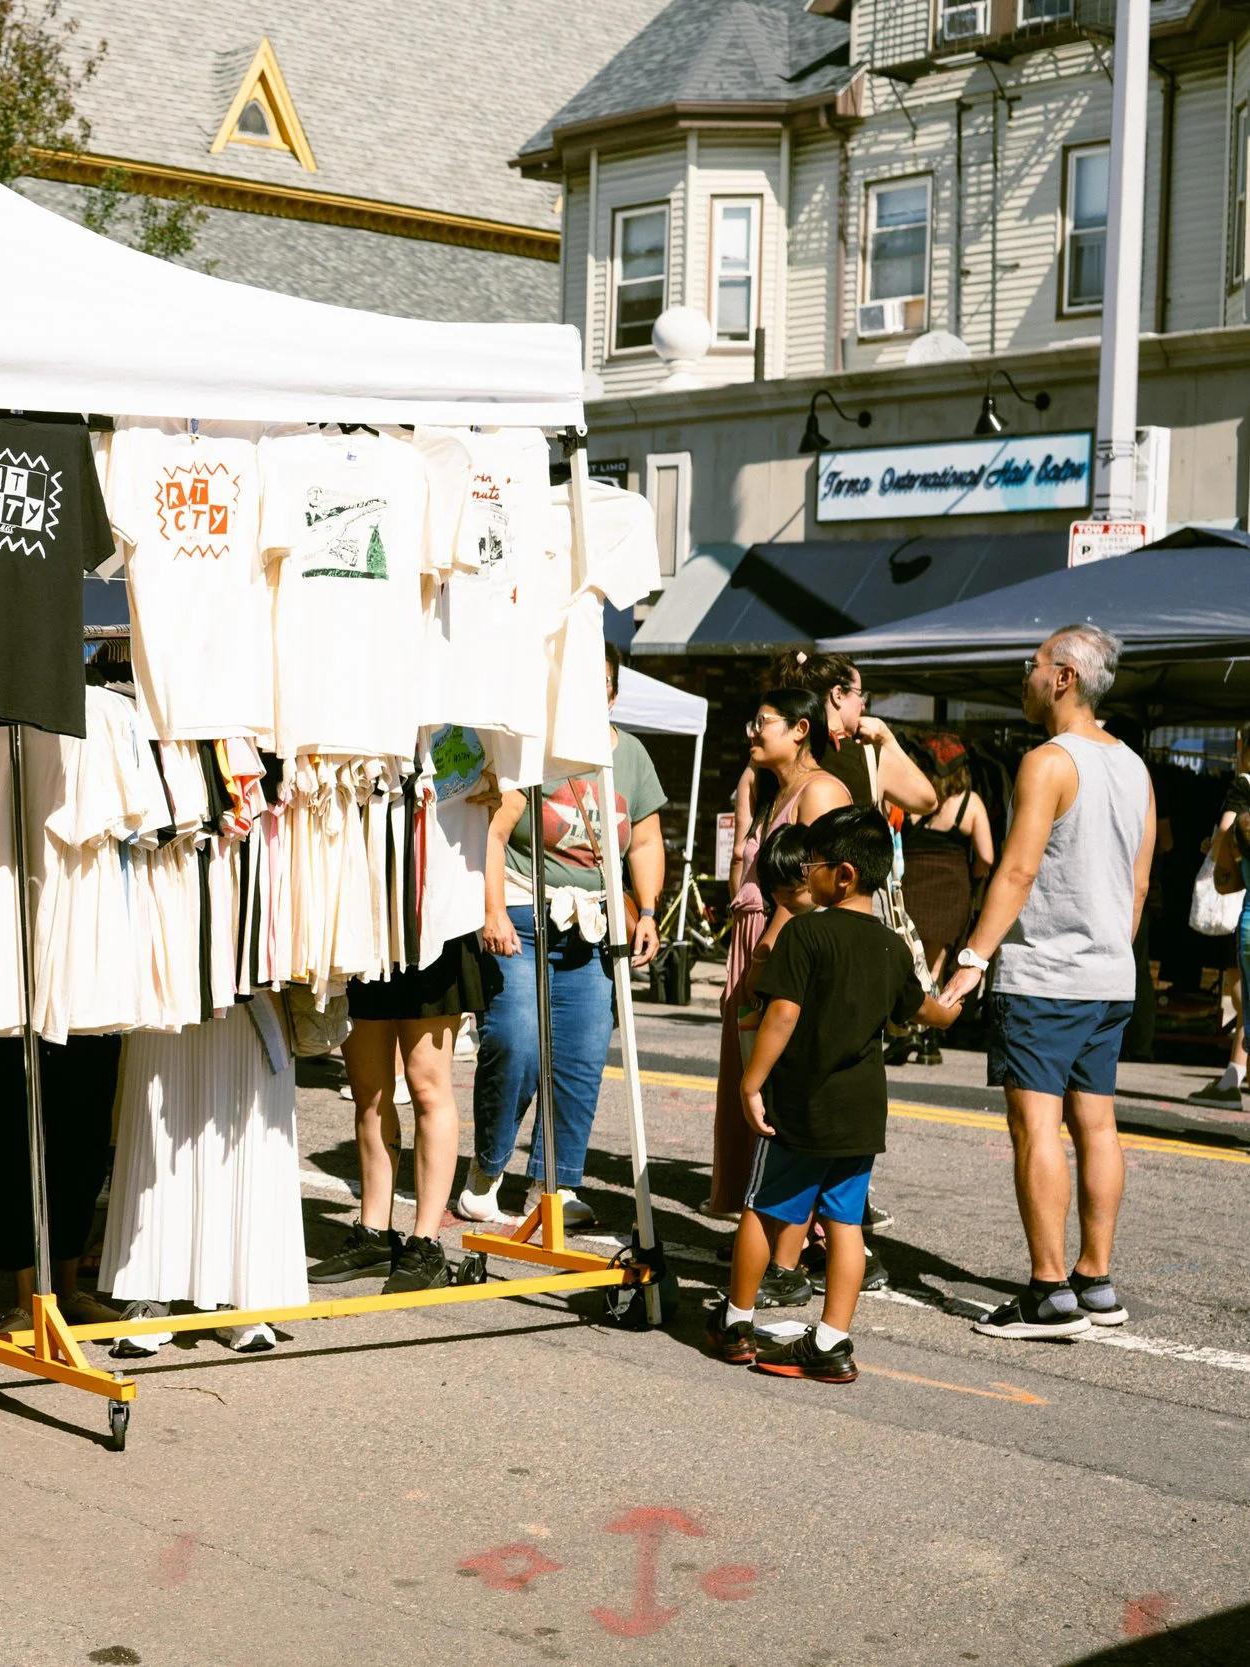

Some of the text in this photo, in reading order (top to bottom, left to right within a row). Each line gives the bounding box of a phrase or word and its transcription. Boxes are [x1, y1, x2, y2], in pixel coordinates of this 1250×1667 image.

[600, 462, 627, 473] LIMO
[984, 458, 1034, 489] Hair
[1077, 524, 1141, 535] TOW ZONE
